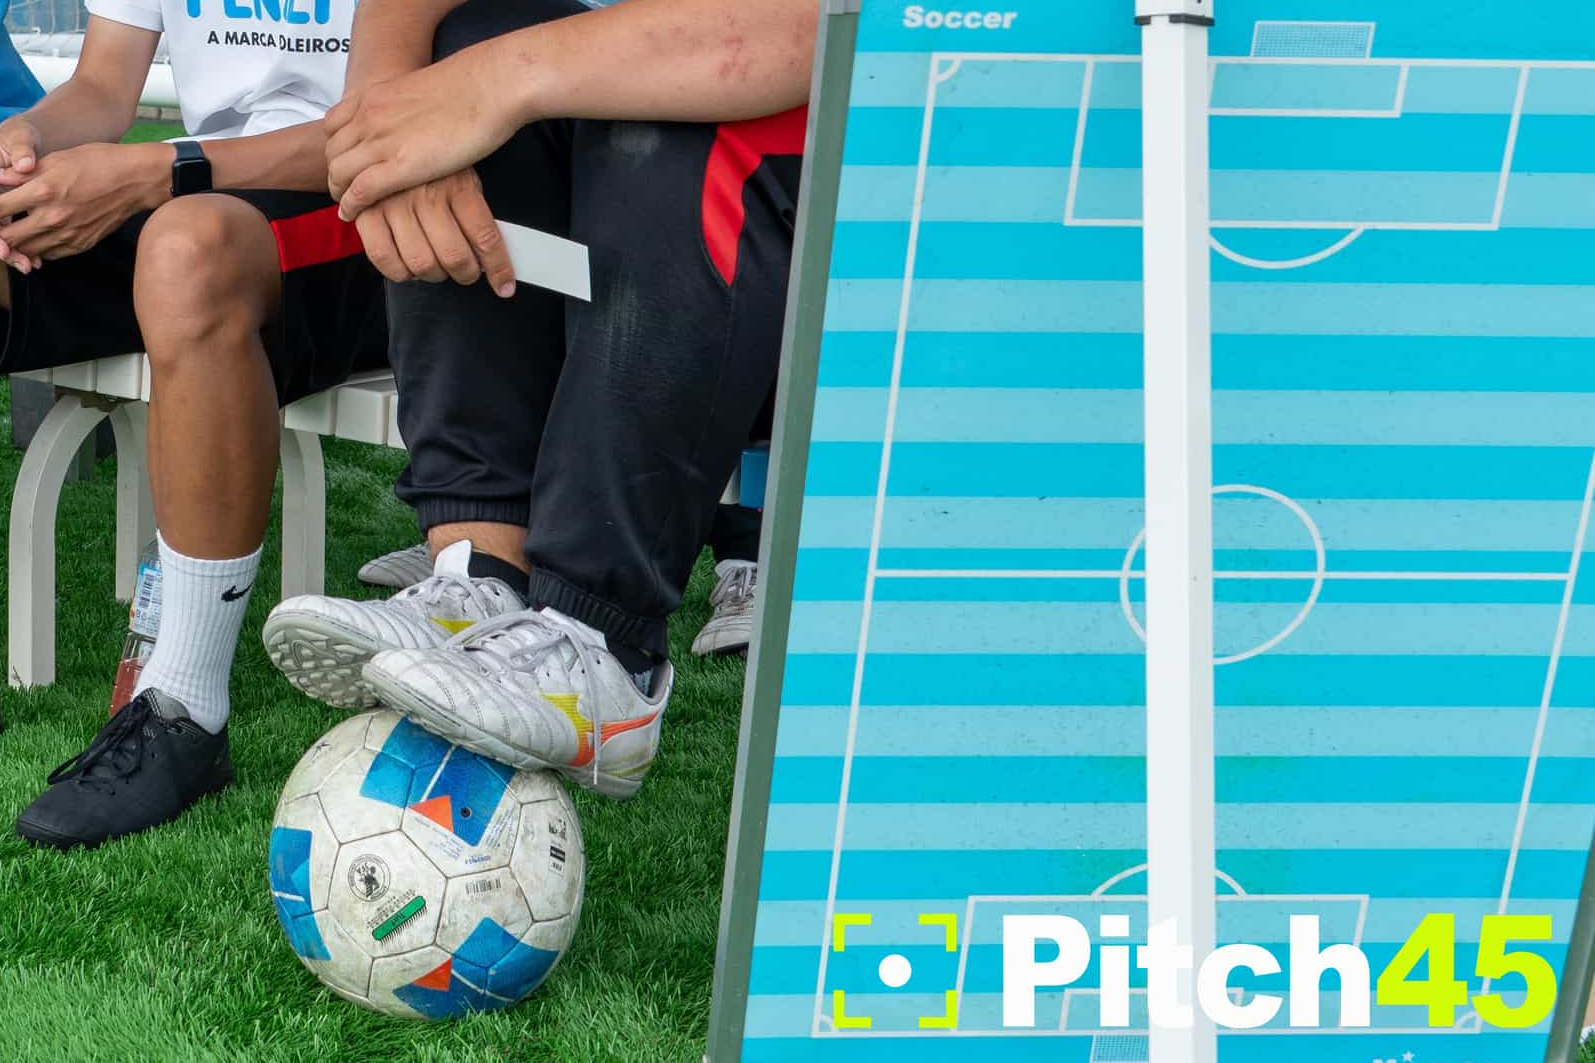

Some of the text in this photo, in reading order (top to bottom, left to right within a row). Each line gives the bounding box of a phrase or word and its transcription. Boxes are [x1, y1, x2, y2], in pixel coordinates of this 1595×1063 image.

[903, 5, 1017, 29] Soccer
[208, 31, 219, 44] A
[225, 32, 276, 47] MARCA
